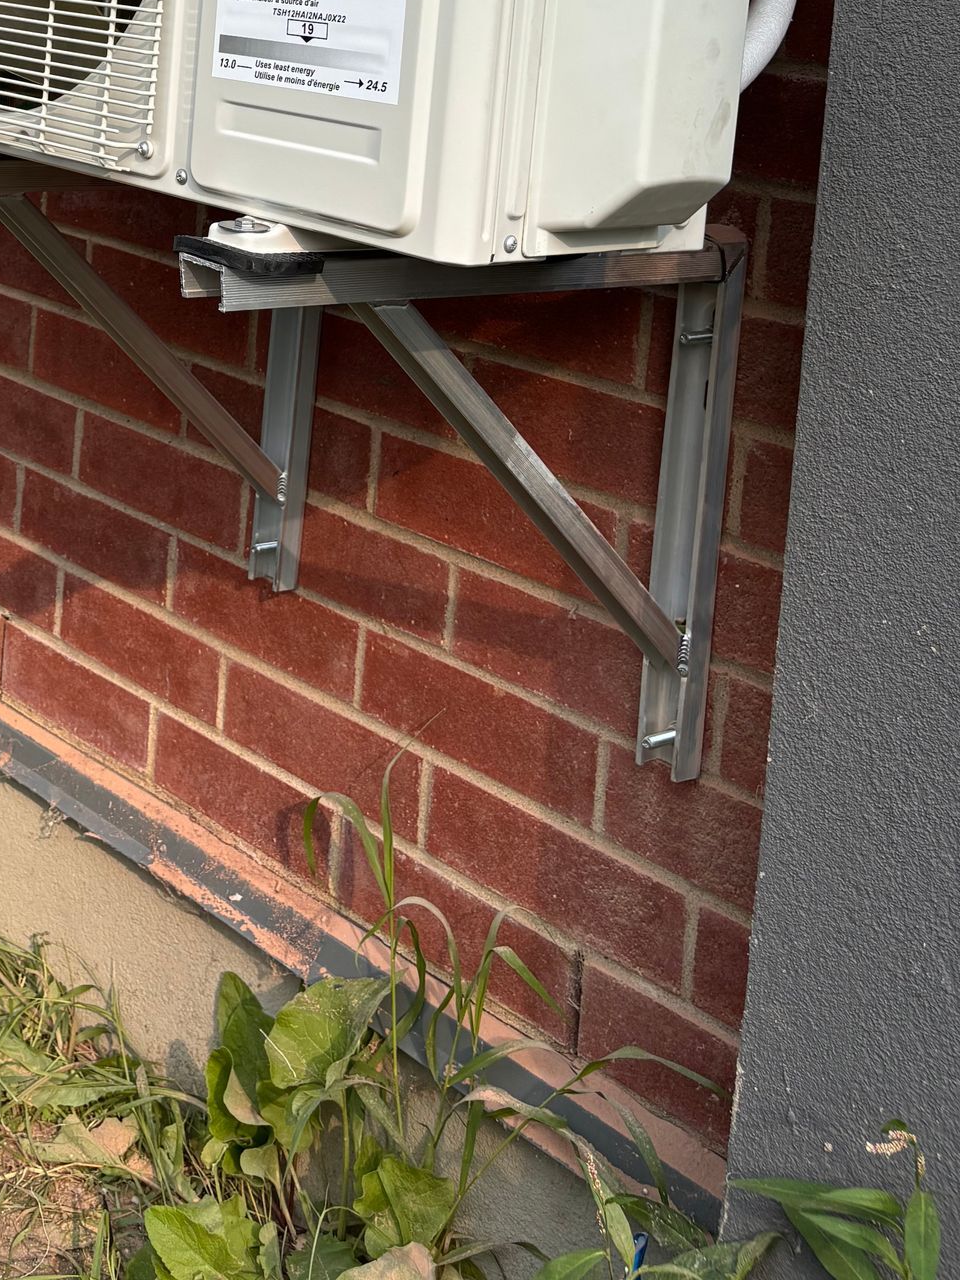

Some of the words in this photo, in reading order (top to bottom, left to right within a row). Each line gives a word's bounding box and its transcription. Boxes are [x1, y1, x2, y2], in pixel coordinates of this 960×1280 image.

[304, 0, 319, 8] d'air
[301, 22, 314, 35] 19
[220, 57, 237, 70] 13.0
[255, 59, 272, 70] Uses
[272, 62, 290, 73] least
[290, 66, 316, 78] energy
[254, 70, 276, 81] Utilise
[276, 73, 284, 83] le
[283, 76, 306, 86] moins
[306, 78, 340, 92] d'énergie
[365, 79, 389, 93] 24.5
